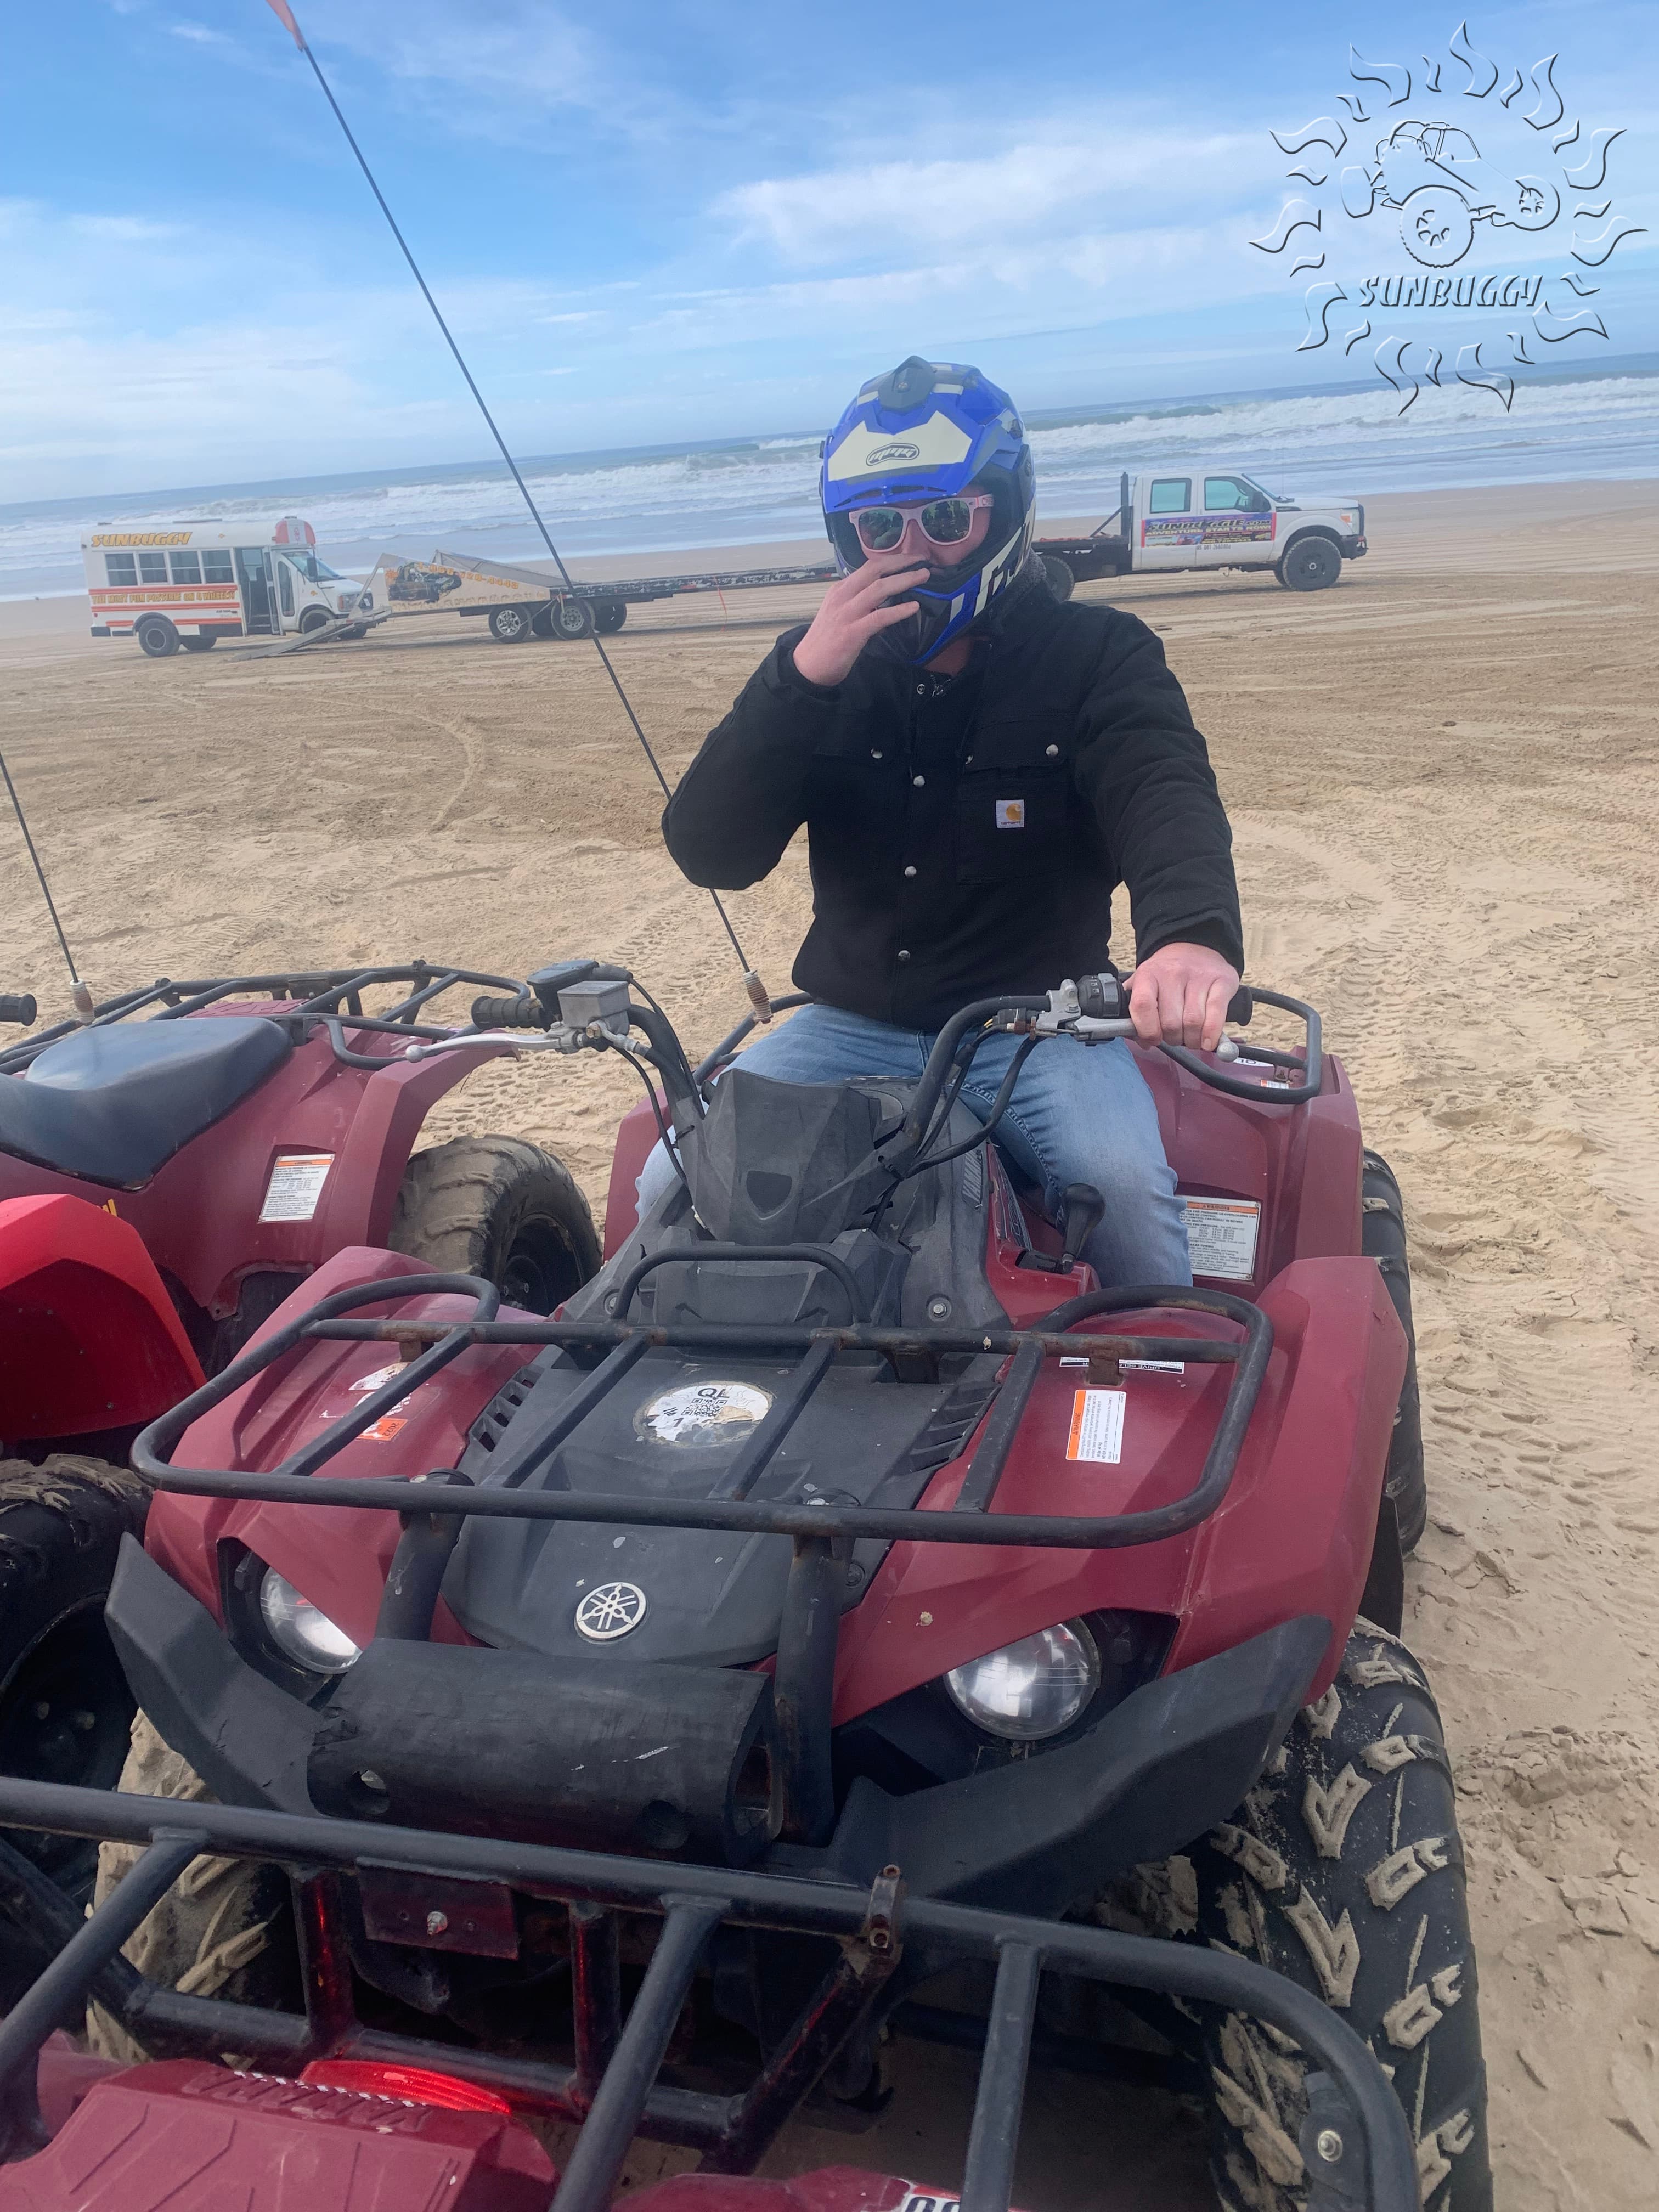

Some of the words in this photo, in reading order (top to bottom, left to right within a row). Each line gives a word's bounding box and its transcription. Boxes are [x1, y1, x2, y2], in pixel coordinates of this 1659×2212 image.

[91, 532, 193, 547] SUNBUGGY
[697, 1387, 730, 1400] QL
[1073, 1412, 1081, 1431] WARNING
